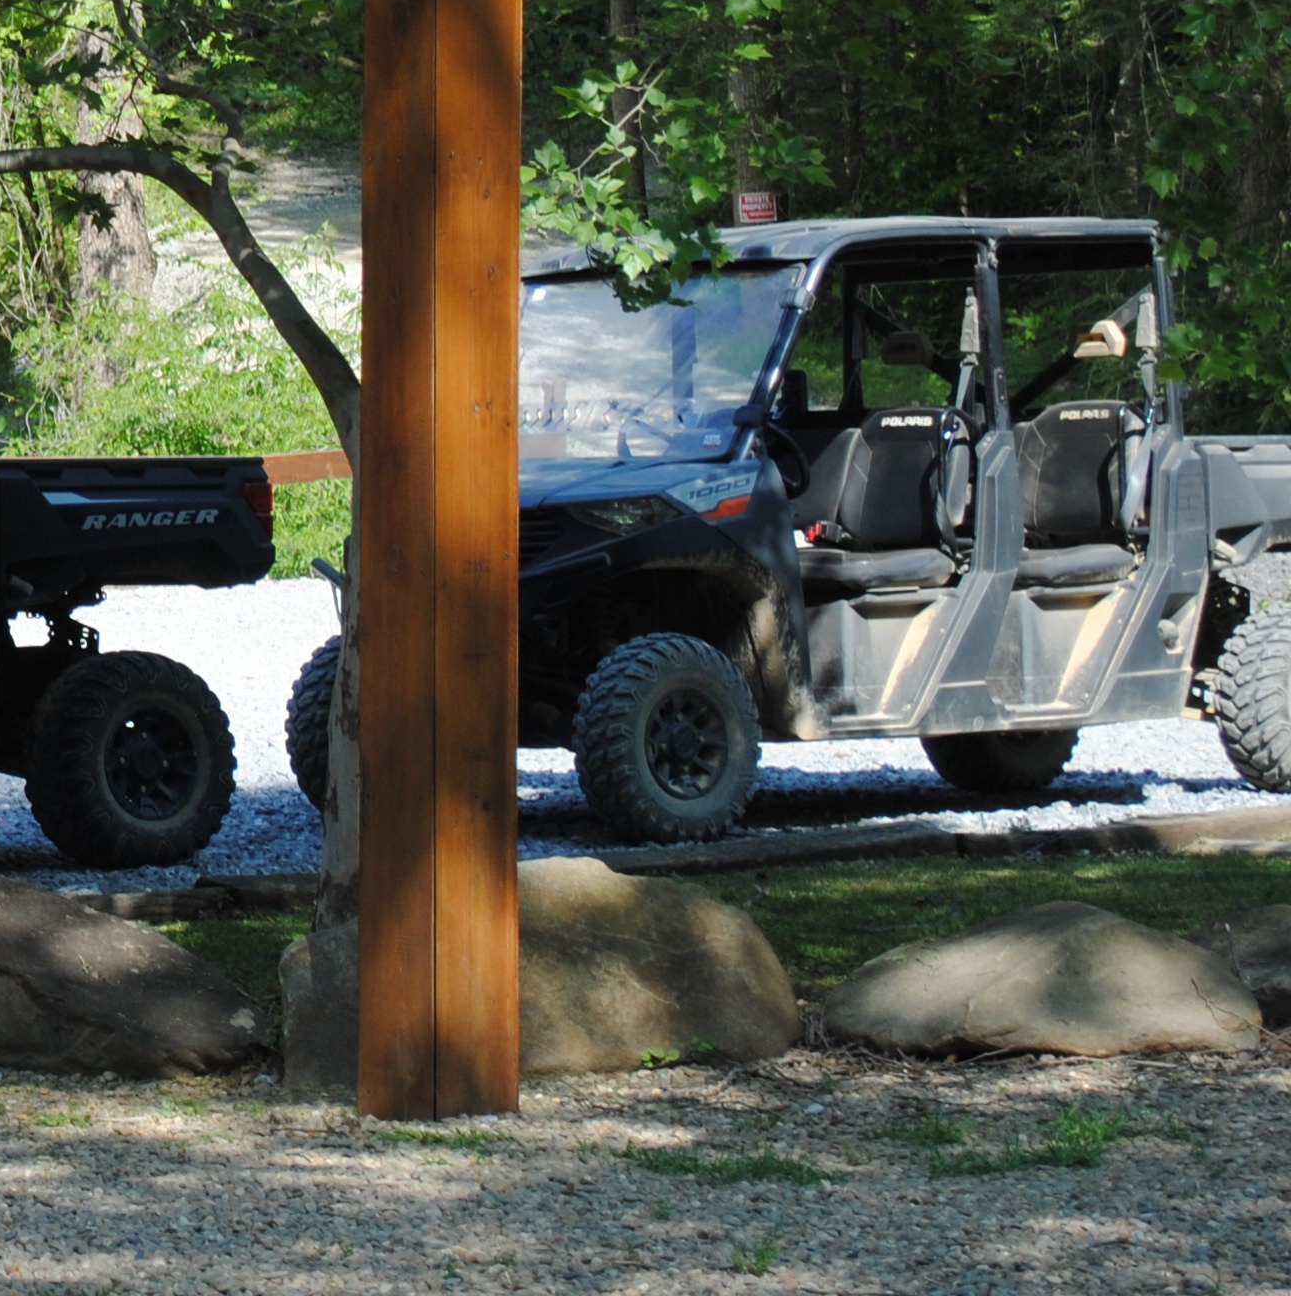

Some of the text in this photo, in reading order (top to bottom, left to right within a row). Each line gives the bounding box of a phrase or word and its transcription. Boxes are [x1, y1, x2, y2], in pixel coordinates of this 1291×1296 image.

[881, 415, 933, 427] POLARIS
[689, 477, 751, 500] 1000
[81, 508, 219, 531] RANGER
